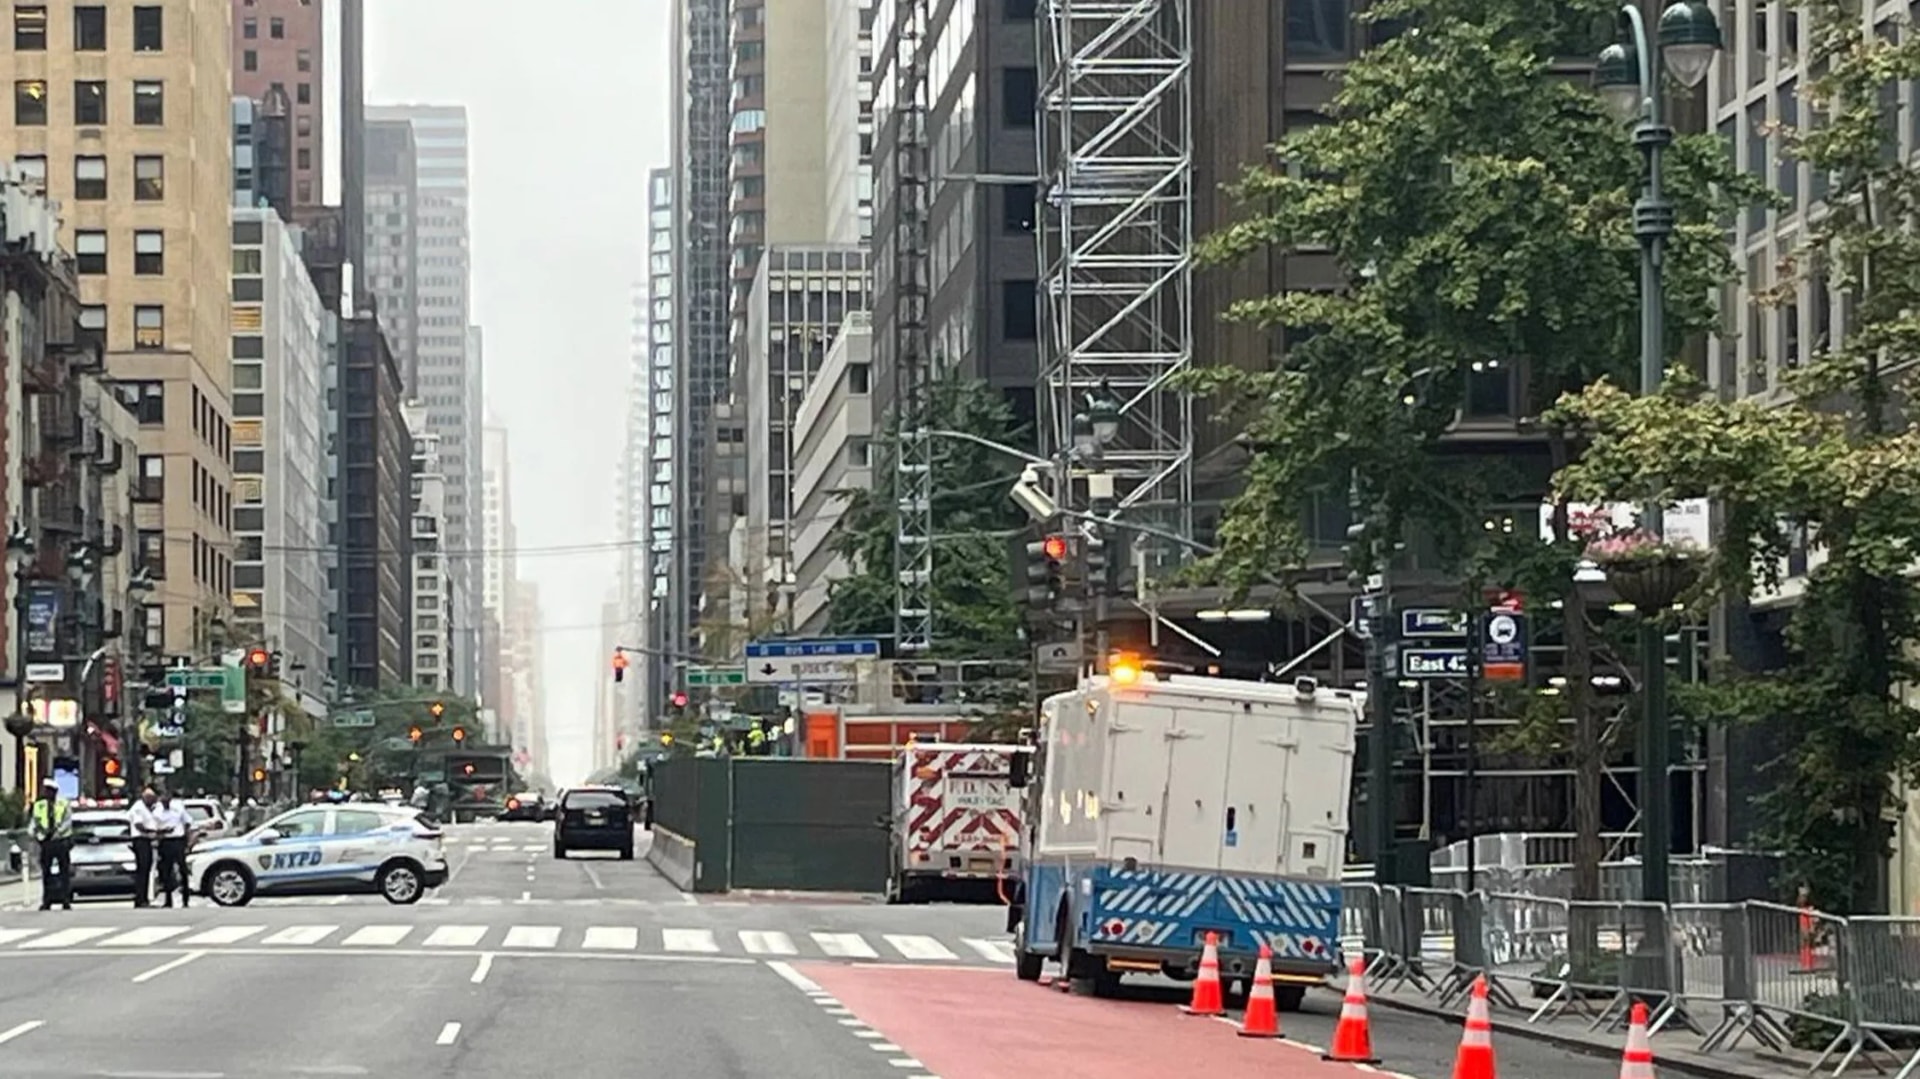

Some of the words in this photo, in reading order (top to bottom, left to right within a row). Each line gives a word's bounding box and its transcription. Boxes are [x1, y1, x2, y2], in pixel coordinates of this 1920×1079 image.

[785, 645, 803, 655] BUS
[811, 643, 837, 654] LANE
[1409, 655, 1445, 671] East
[274, 850, 322, 868] NYPD
